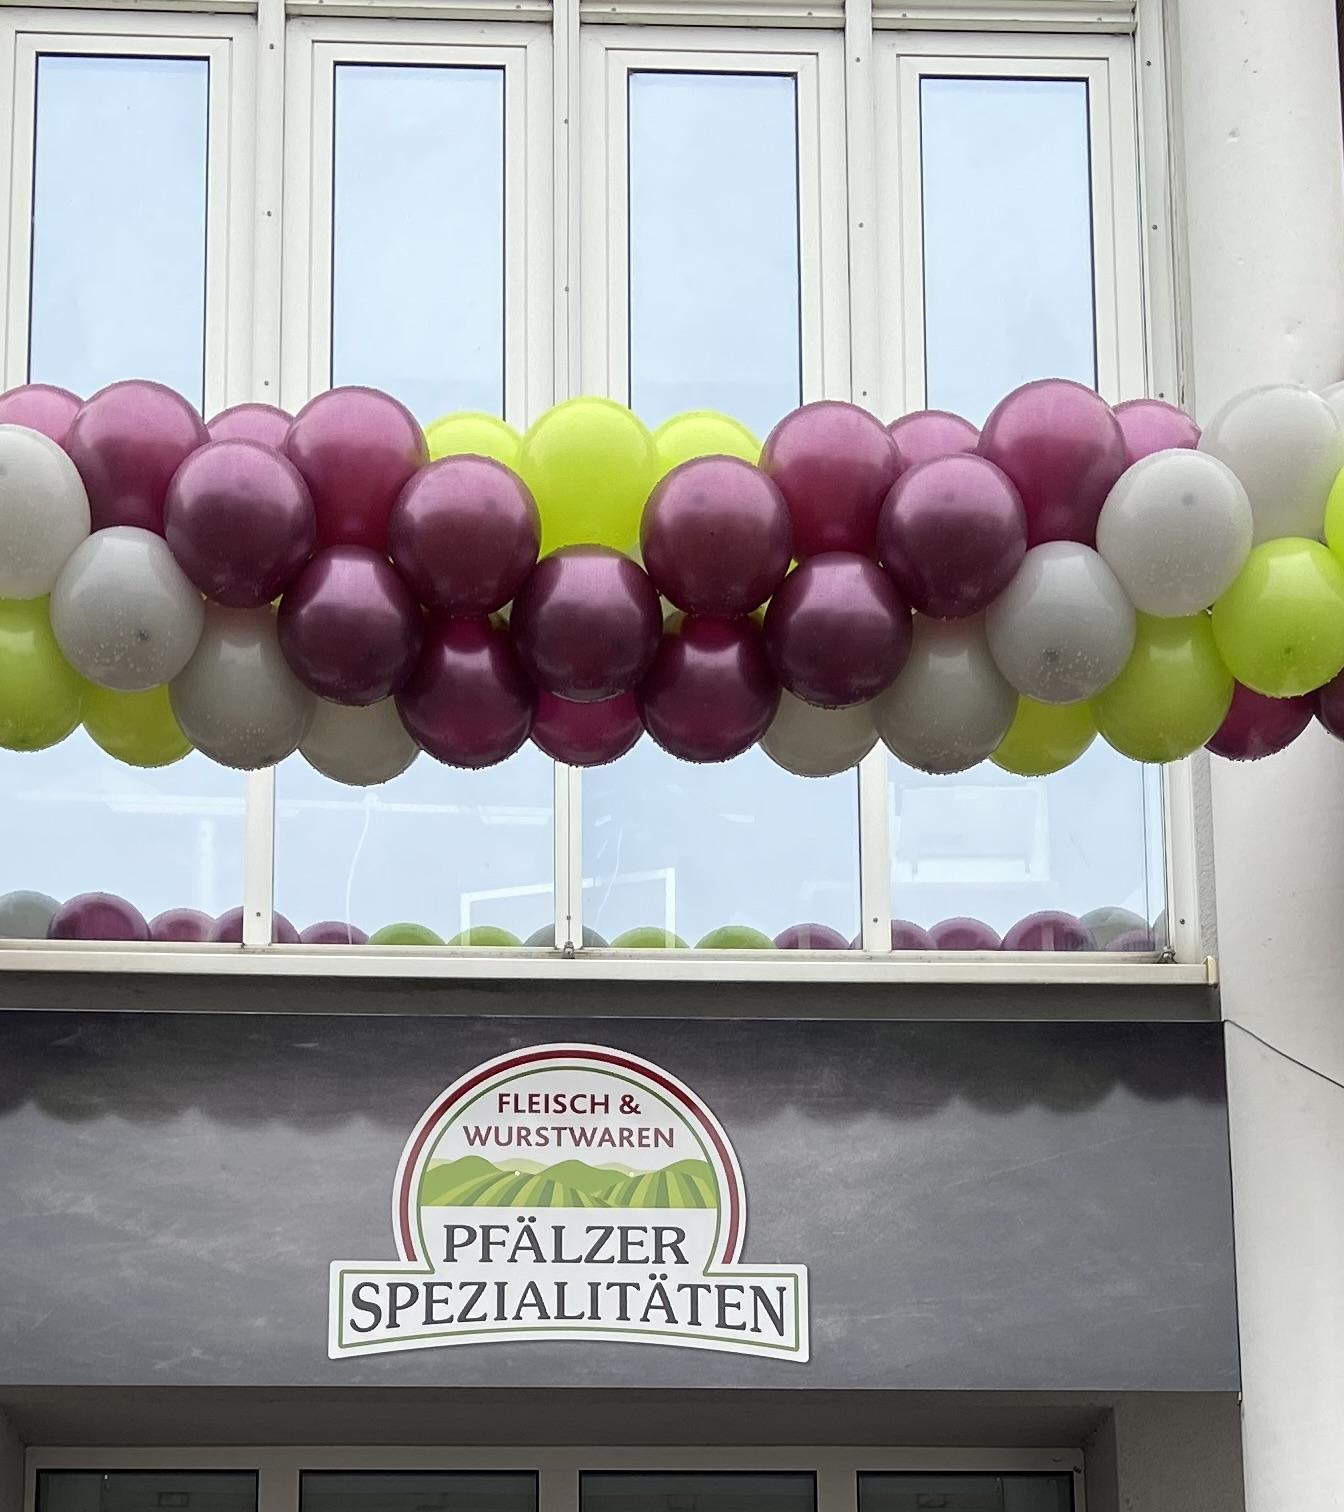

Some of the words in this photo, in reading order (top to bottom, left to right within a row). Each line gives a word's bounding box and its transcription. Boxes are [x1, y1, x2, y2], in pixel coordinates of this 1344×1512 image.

[497, 1092, 610, 1116] FLEISCH
[618, 1093, 642, 1116] &
[463, 1125, 675, 1149] WURSTWAREN
[443, 1215, 689, 1265] PFÄLZER
[349, 1272, 787, 1337] SPEZIALITÄTEN
